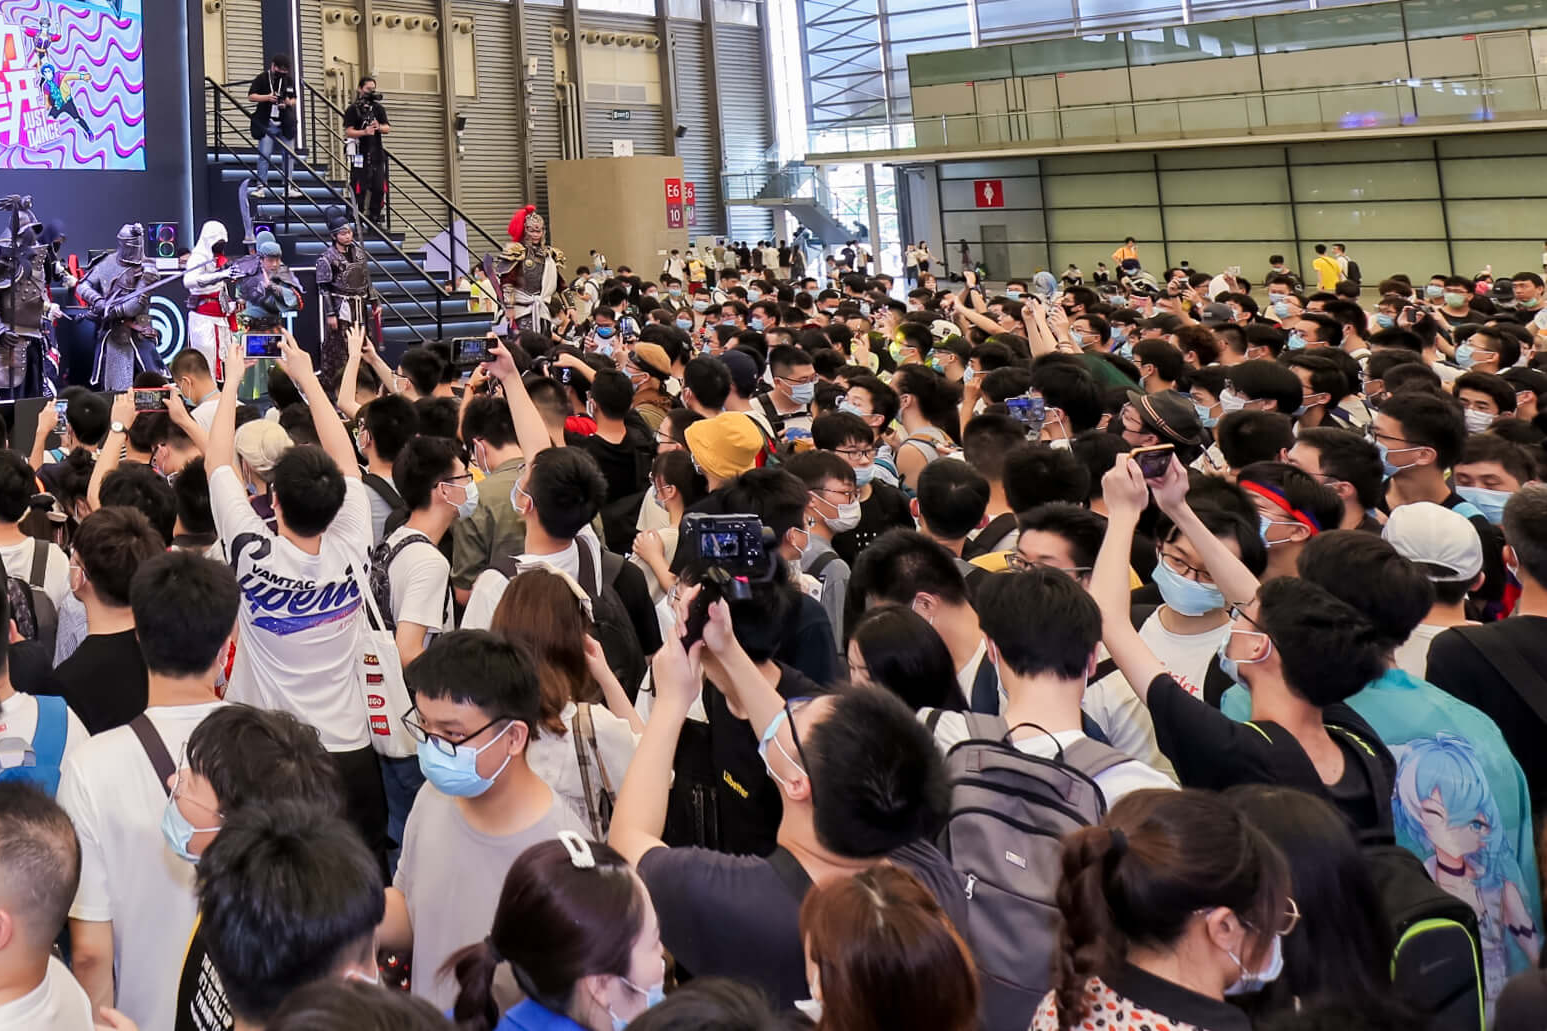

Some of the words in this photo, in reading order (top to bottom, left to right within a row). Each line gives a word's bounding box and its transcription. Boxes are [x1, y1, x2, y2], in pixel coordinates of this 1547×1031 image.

[23, 108, 48, 131] JUST
[26, 121, 61, 149] DANCE
[667, 184, 680, 198] E6
[670, 209, 681, 222] 10
